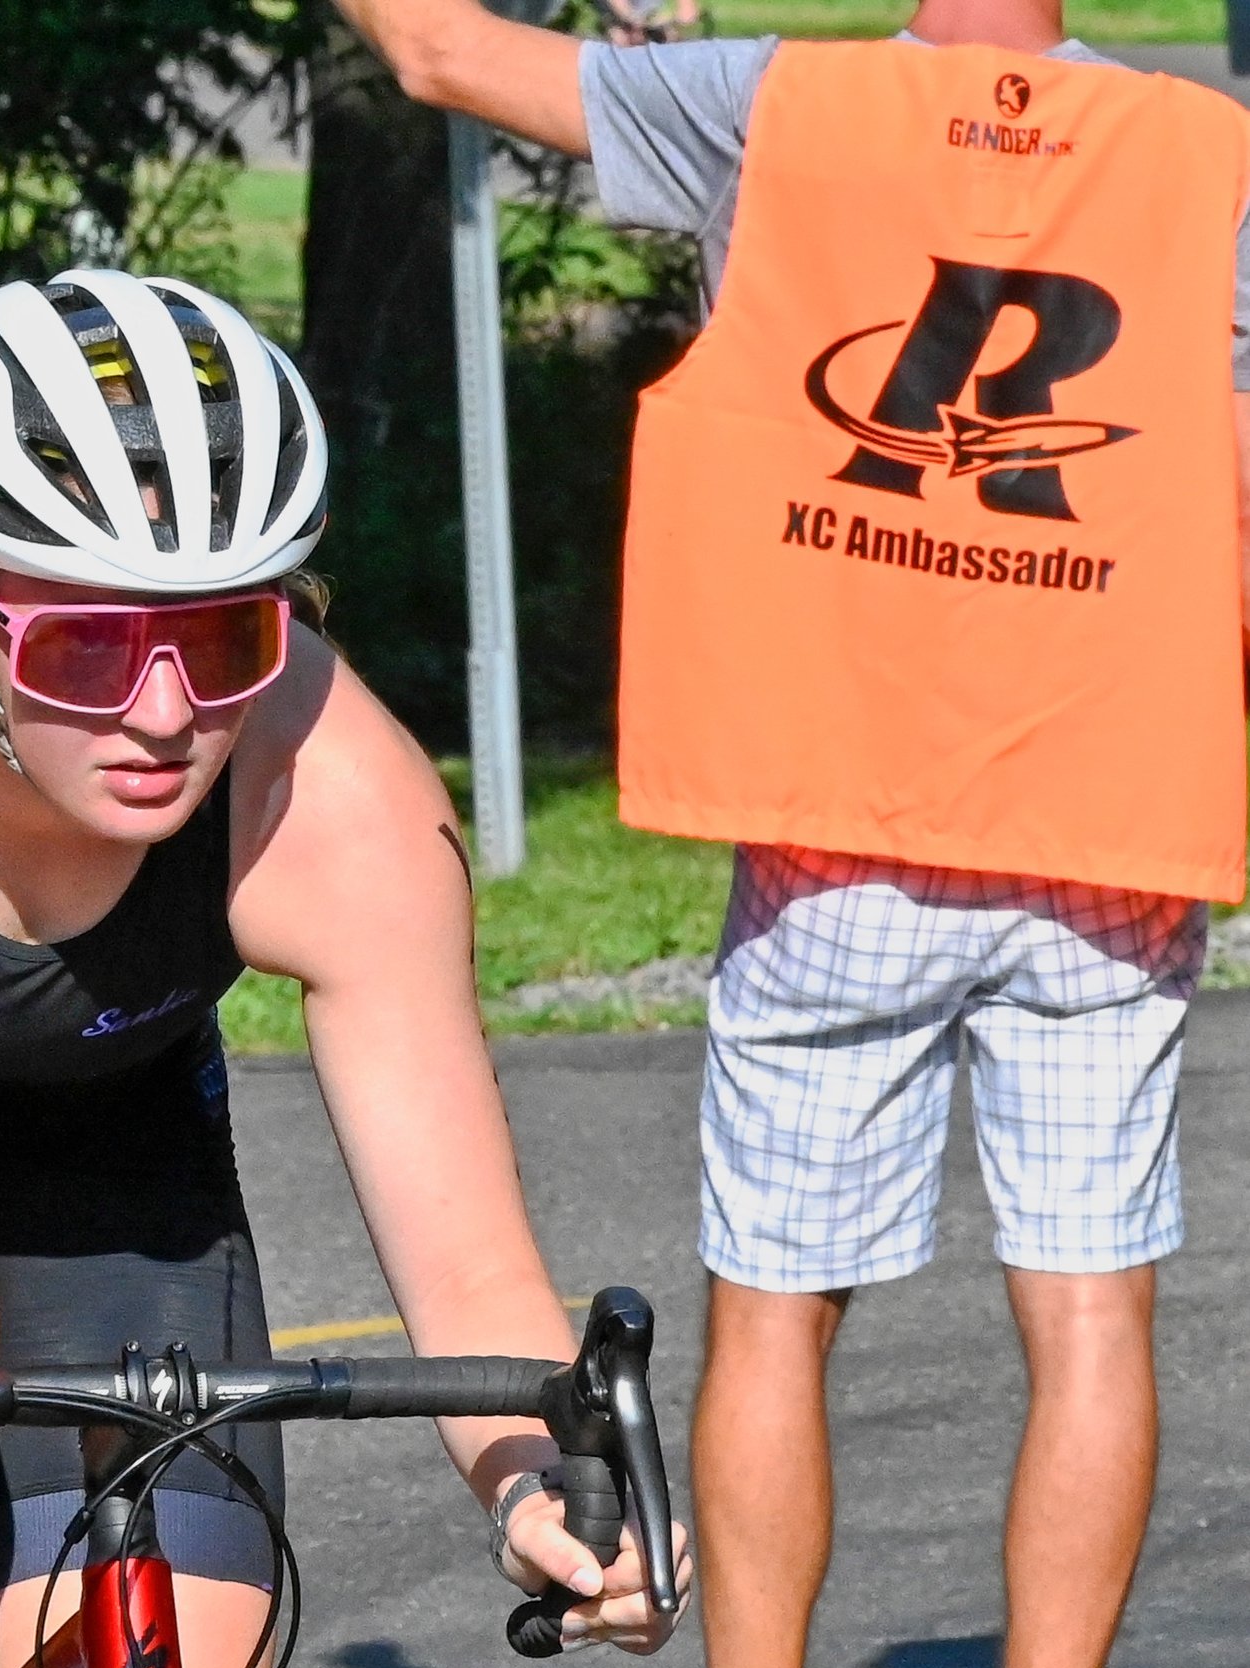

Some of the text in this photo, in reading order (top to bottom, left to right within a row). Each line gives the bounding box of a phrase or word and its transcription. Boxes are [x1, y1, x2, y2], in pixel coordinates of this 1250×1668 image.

[947, 117, 1042, 156] GANDER
[782, 501, 1117, 594] XC Ambassador
